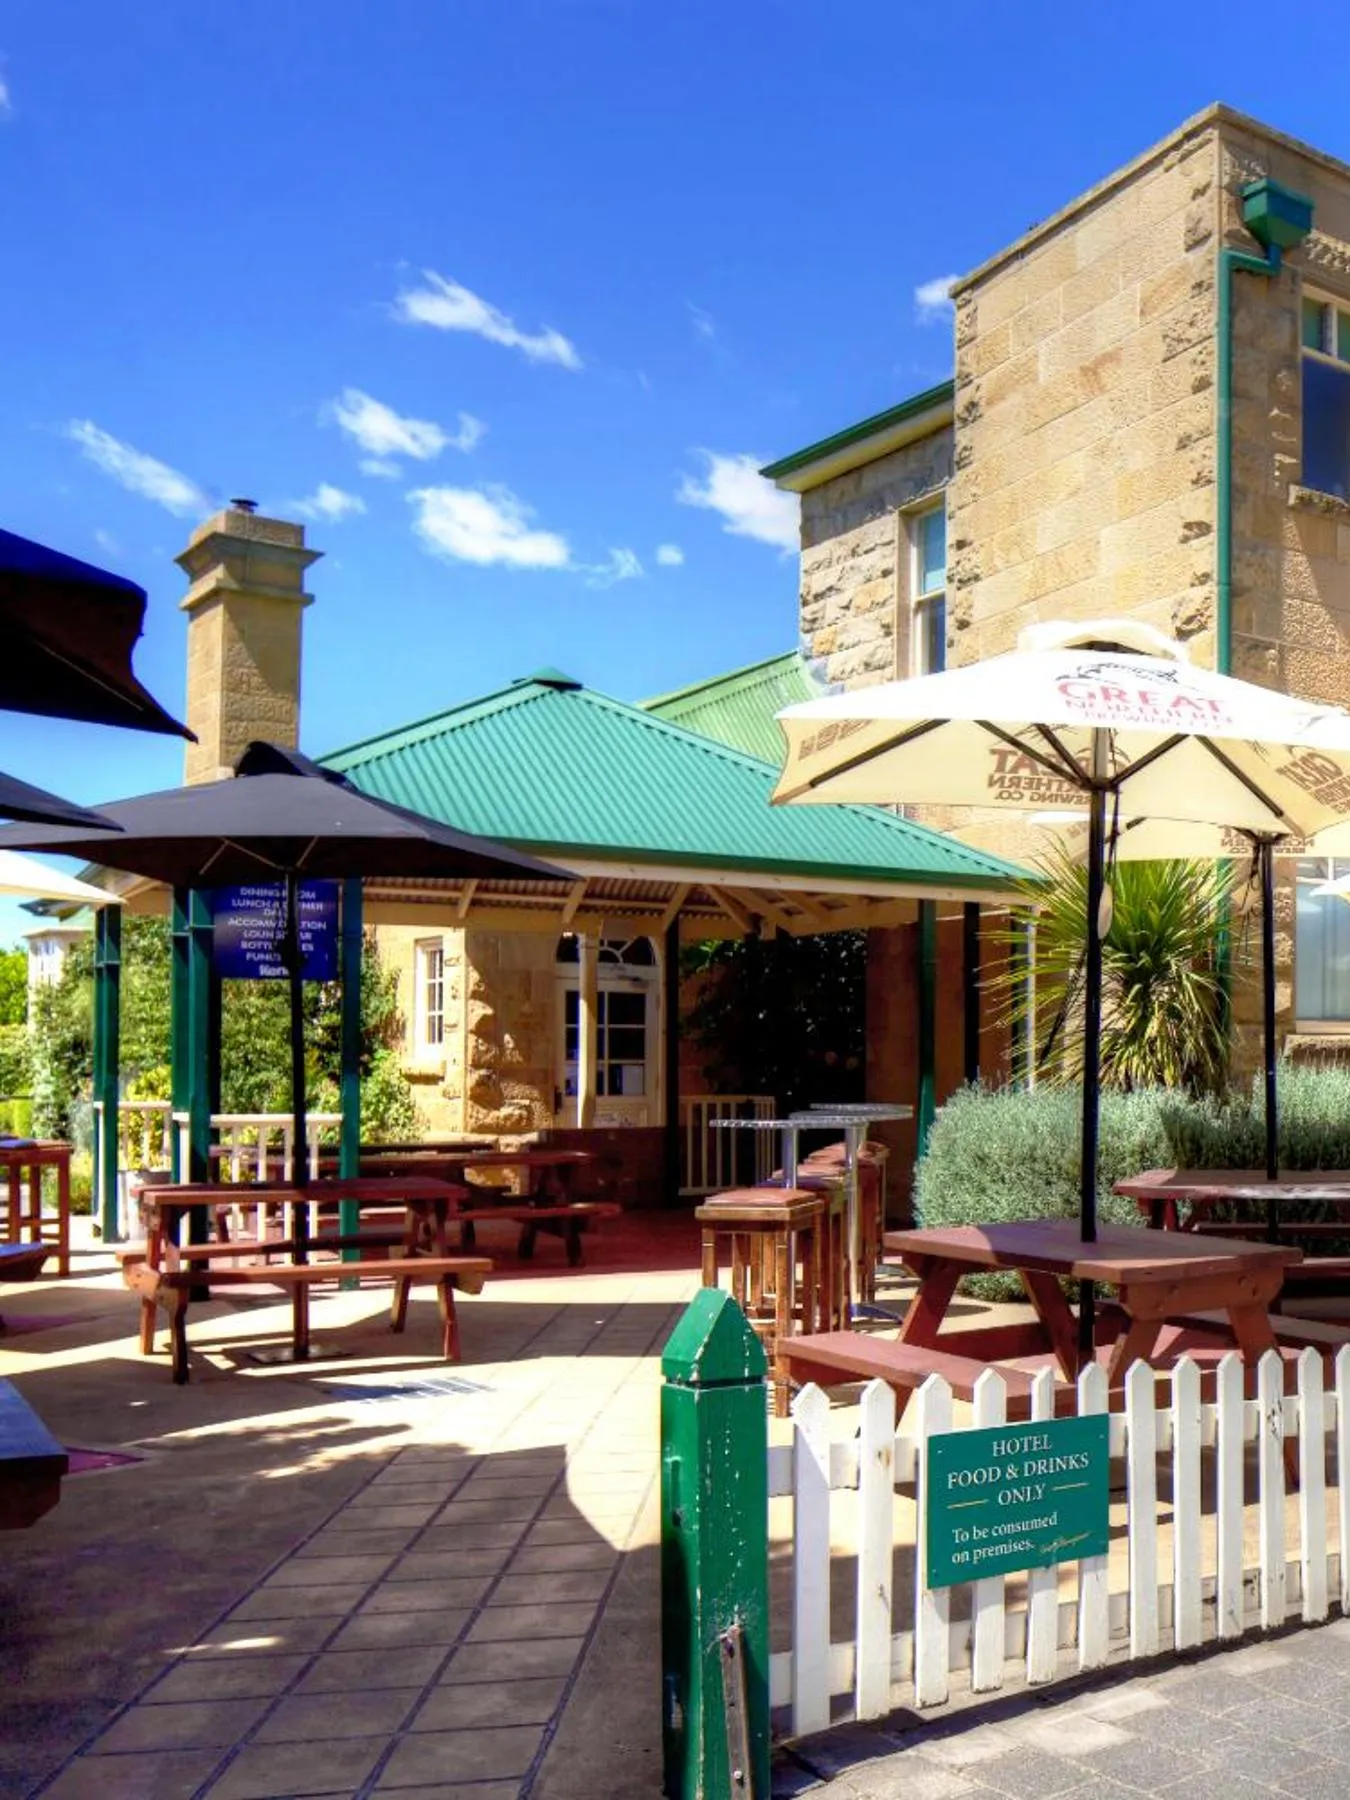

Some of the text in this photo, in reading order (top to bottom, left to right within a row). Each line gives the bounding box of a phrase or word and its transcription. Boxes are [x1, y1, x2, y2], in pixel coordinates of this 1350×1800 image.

[1058, 681, 1225, 713] GREAT
[992, 1434, 1052, 1457] HOTEL
[947, 1451, 1090, 1490] FOOD & DRINKS
[997, 1482, 1047, 1507] ONLY
[952, 1511, 1059, 1545] To be consumed
[952, 1537, 1036, 1566] on premises.
